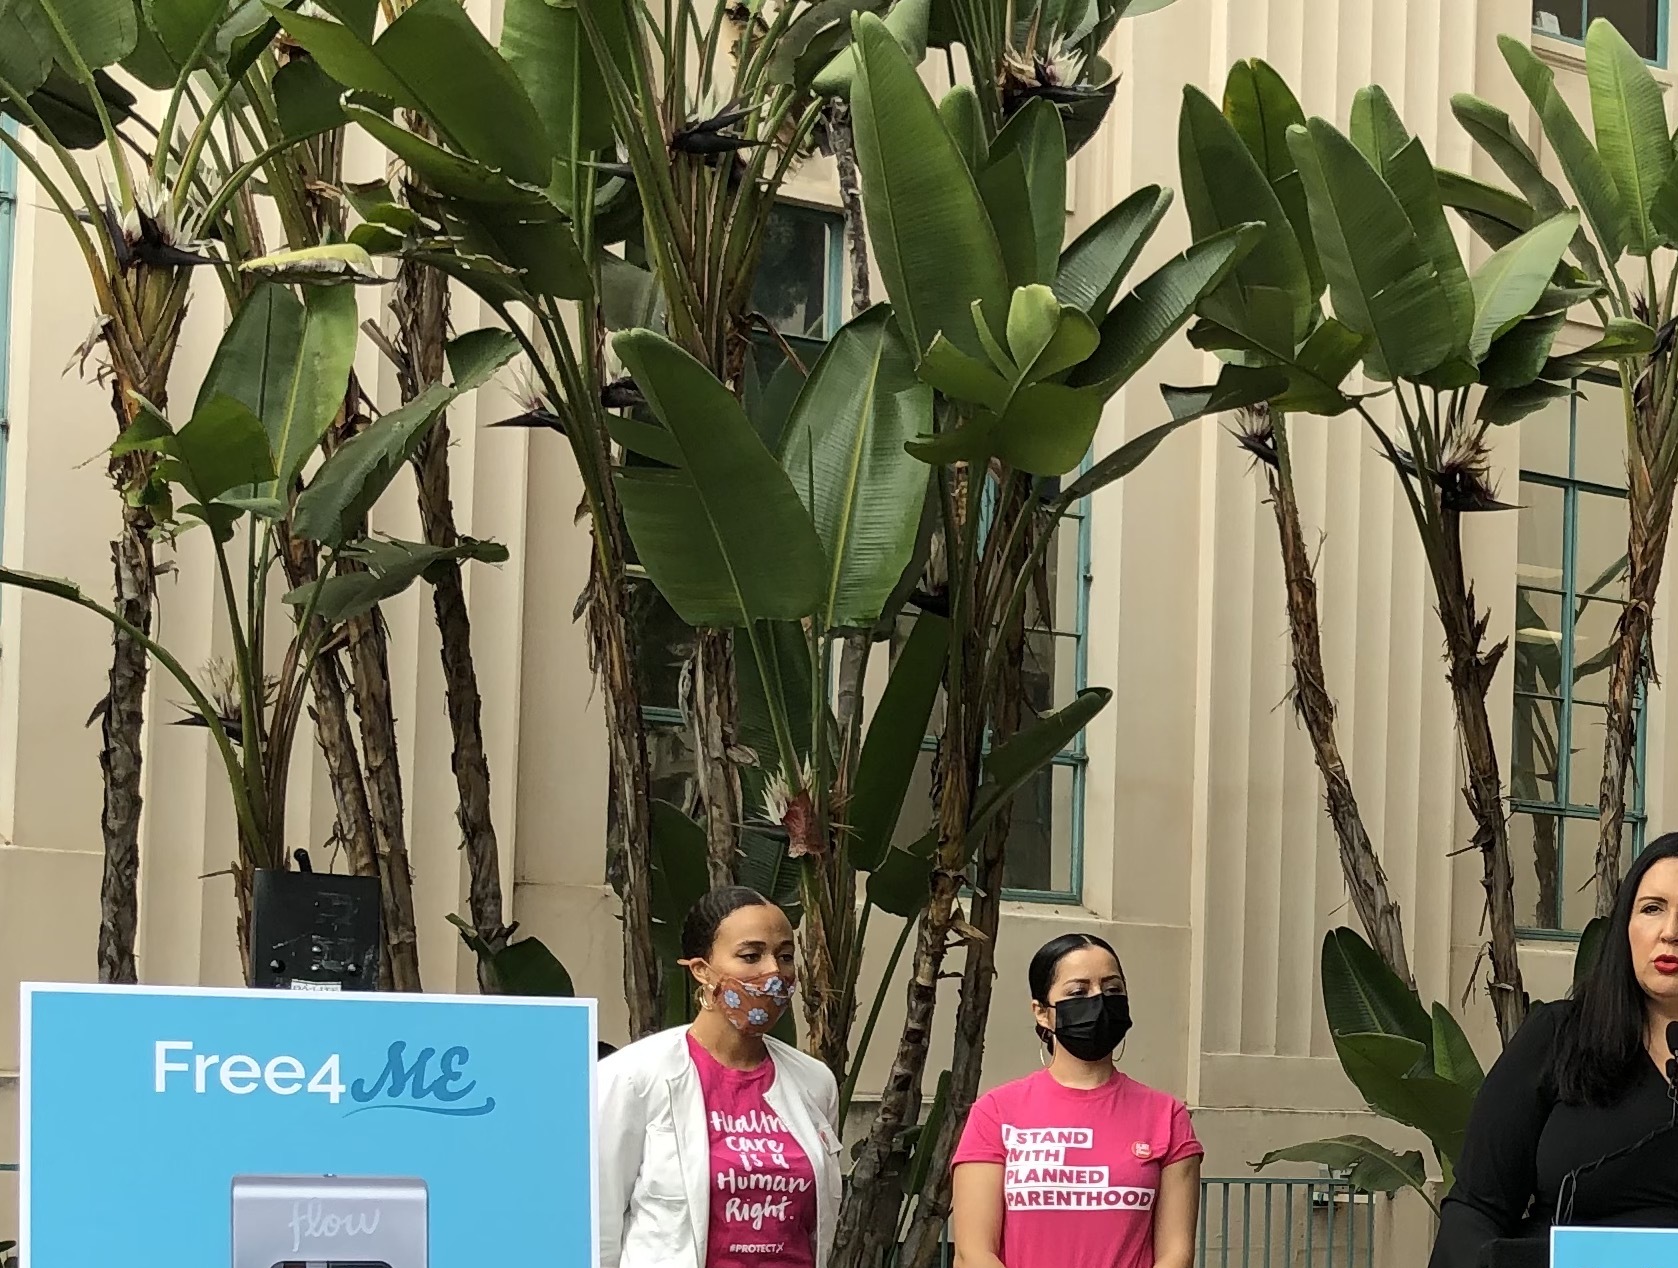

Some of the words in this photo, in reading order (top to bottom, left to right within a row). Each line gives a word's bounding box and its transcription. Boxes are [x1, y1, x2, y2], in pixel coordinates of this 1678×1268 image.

[724, 1135, 784, 1154] care
[1004, 1127, 1011, 1141] I
[1016, 1131, 1089, 1145] STAND
[1008, 1149, 1060, 1162] WITH
[716, 1168, 813, 1195] Human
[1006, 1168, 1105, 1184] PLANNED
[1007, 1190, 1152, 1207] PARENTHOOD
[724, 1195, 795, 1231] Right.
